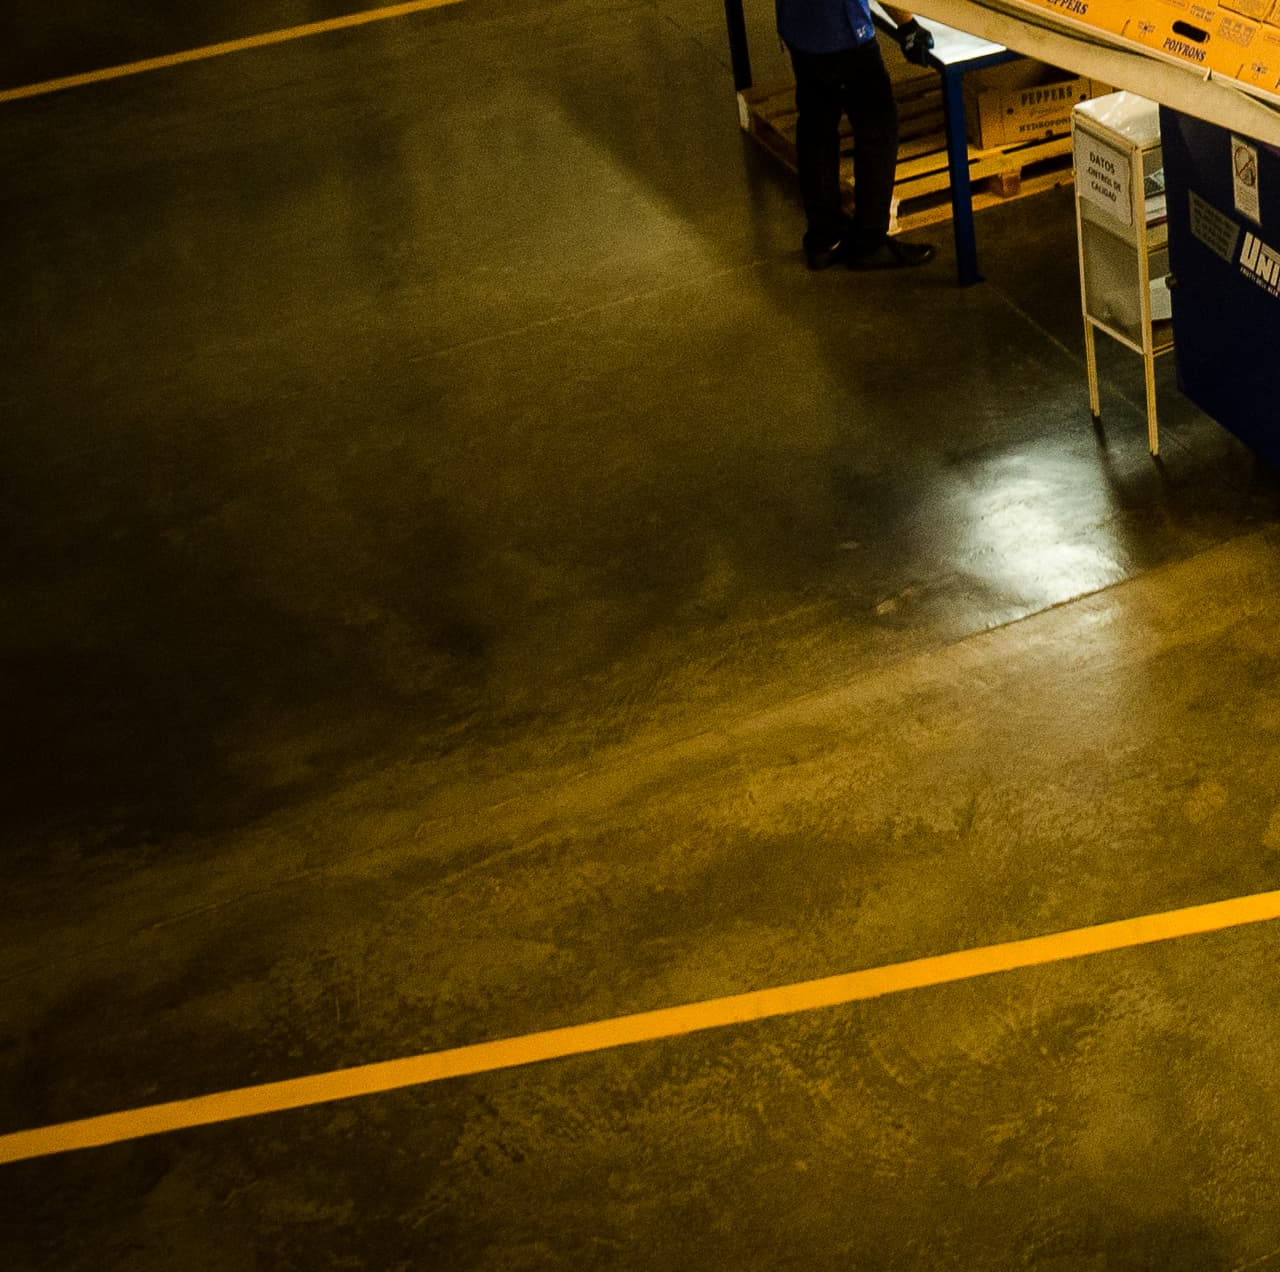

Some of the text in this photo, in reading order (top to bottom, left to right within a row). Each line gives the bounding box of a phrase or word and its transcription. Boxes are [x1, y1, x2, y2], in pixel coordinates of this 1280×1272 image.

[1163, 38, 1206, 62] POIVRONS
[1021, 86, 1072, 106] PEPPERS
[1090, 152, 1115, 174] DATOS
